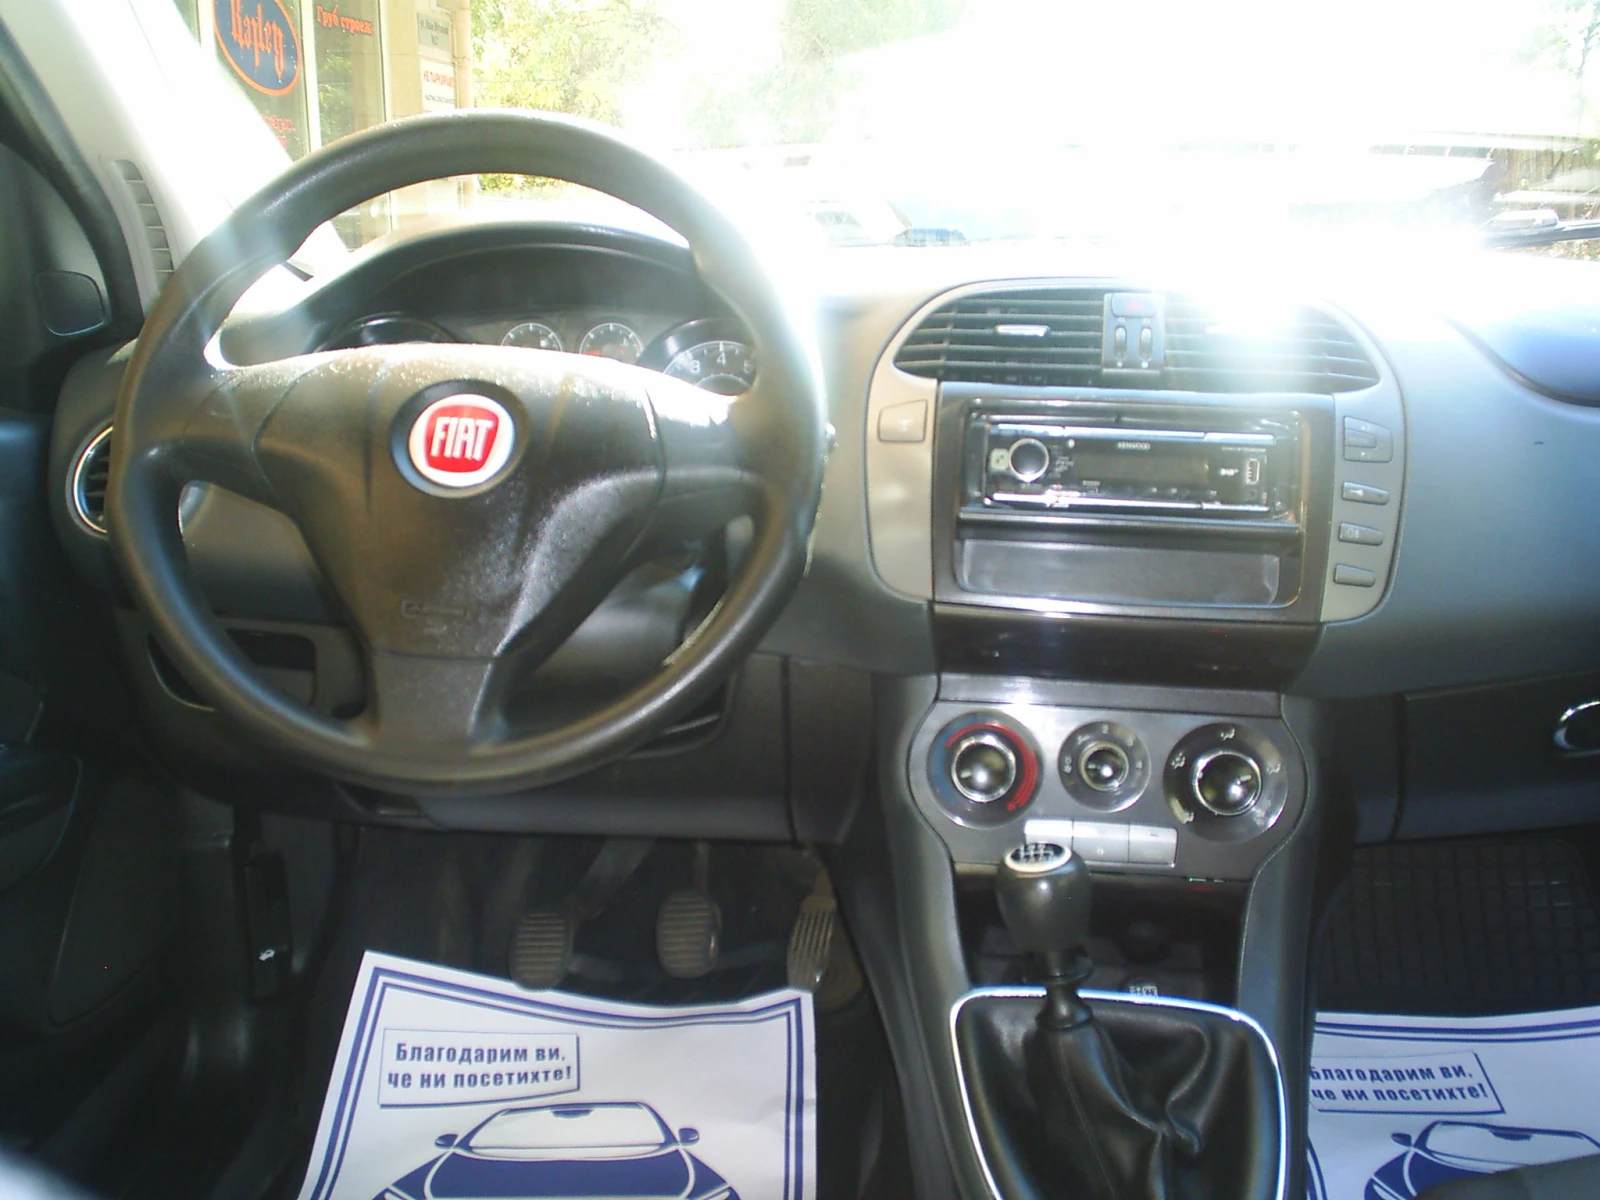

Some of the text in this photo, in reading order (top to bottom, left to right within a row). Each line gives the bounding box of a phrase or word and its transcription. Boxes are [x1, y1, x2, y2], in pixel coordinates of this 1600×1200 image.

[716, 351, 727, 368] 4
[430, 416, 494, 462] FIAT
[1117, 441, 1151, 451] KENWOOD
[395, 1043, 528, 1065] Благодарим
[388, 1065, 572, 1089] че ни посетихте!
[1311, 1082, 1489, 1101] че ни посетихте!
